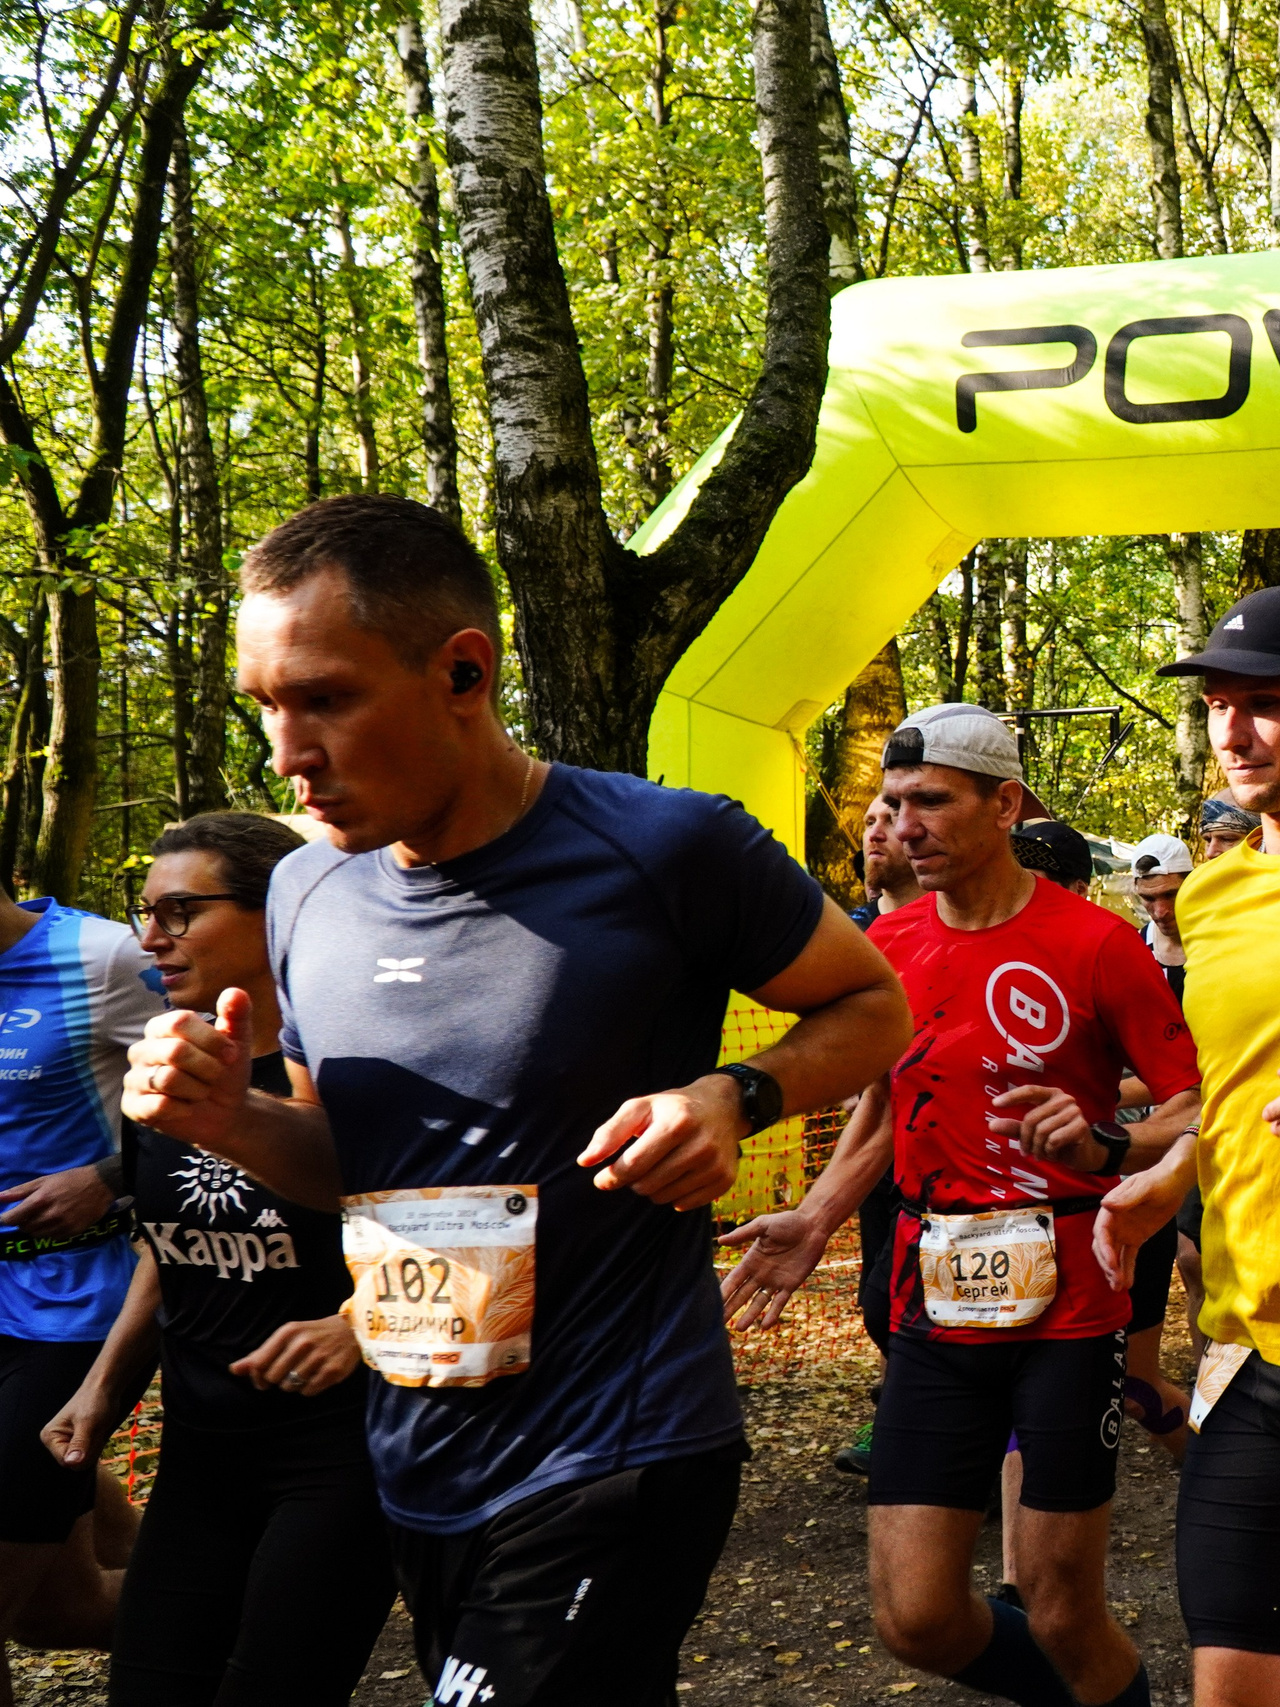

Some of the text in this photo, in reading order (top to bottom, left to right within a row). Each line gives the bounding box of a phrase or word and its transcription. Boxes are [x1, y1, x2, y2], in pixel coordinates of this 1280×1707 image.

[142, 1222, 302, 1282] Kappa
[950, 1250, 1010, 1282] 120
[376, 1257, 451, 1304] 102
[956, 1282, 1009, 1301] Сергей
[365, 1309, 466, 1341] Владимир
